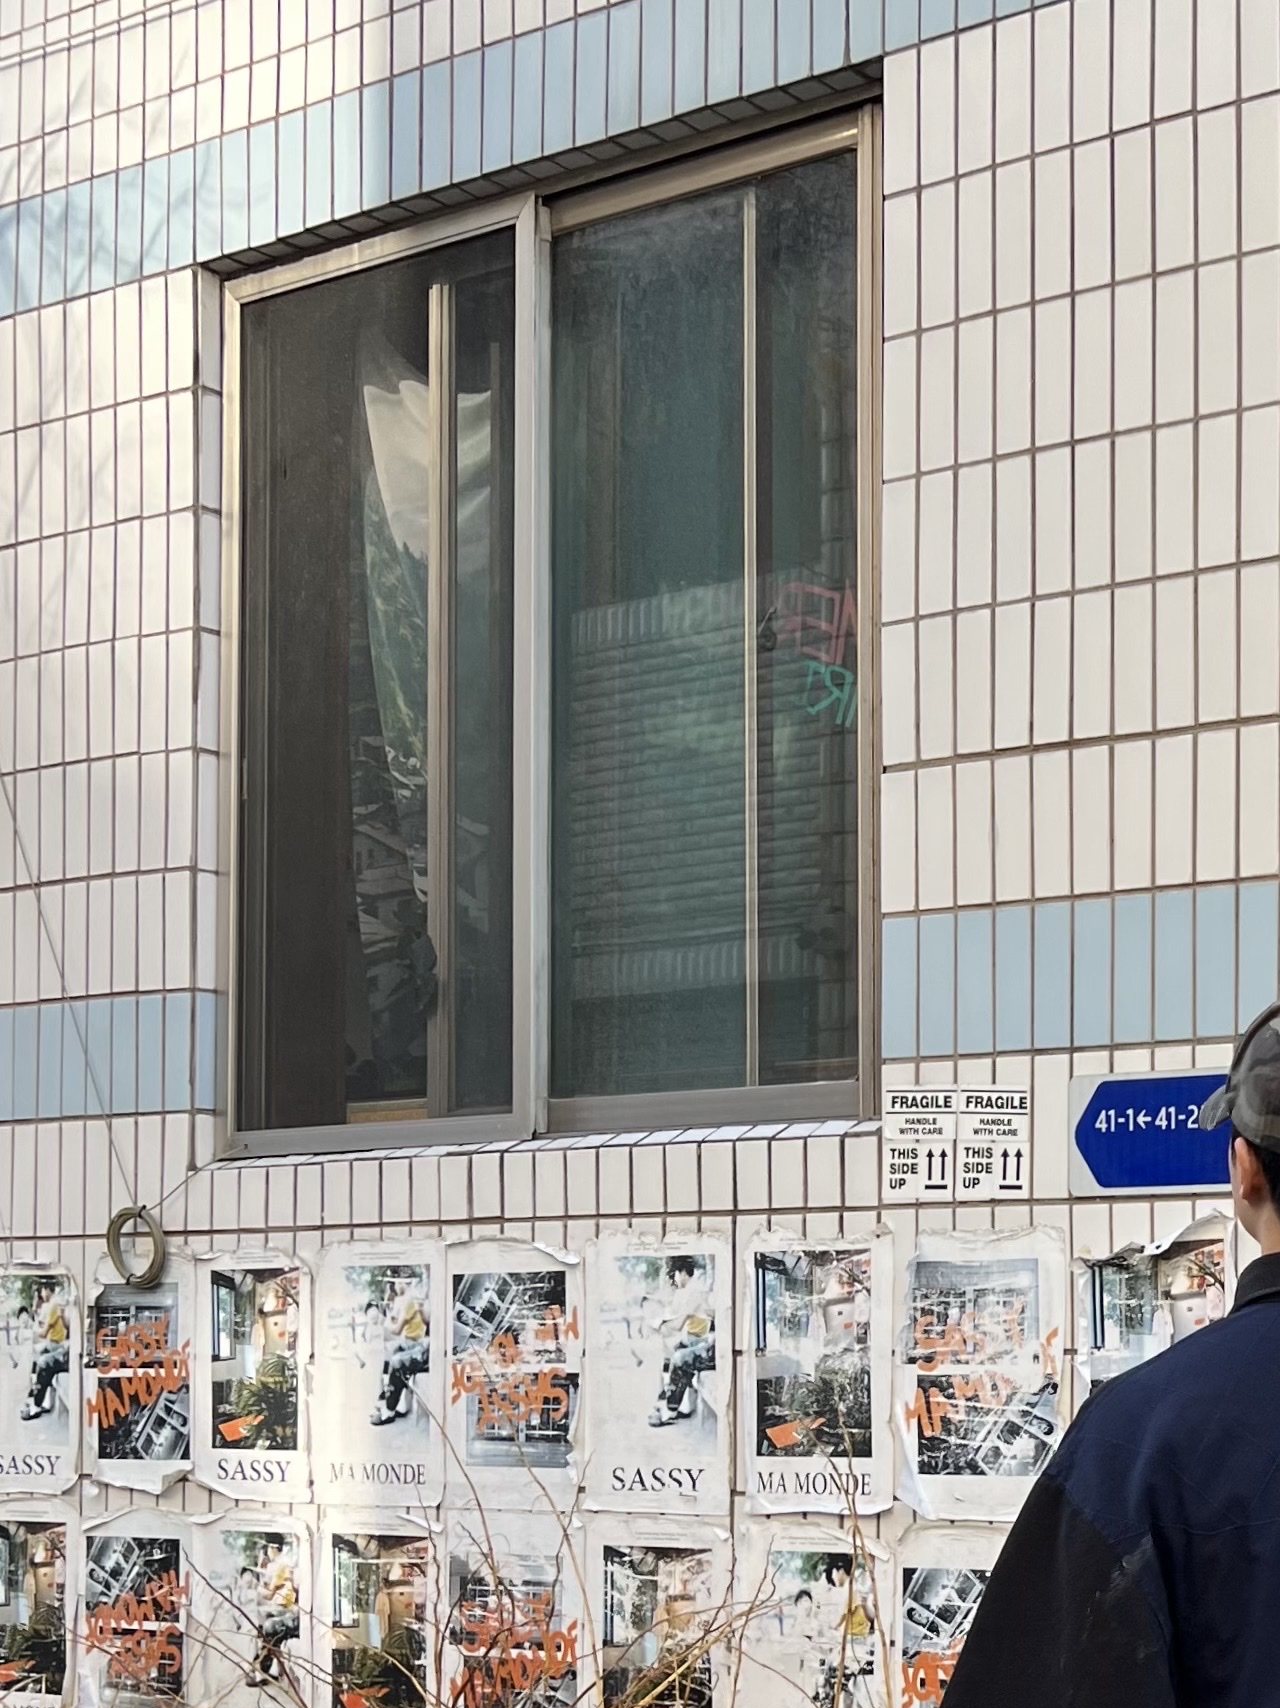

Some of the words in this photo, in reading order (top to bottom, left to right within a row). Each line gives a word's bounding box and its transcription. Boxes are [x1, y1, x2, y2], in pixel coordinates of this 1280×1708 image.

[891, 1095, 952, 1109] FRAGILE
[965, 1096, 1028, 1110] FRAGILE
[904, 1117, 937, 1125] HANDLE
[979, 1118, 1012, 1127] HANDLE
[898, 1127, 919, 1136] WITH
[921, 1127, 943, 1135] CARE
[973, 1128, 994, 1136] WITH
[995, 1128, 1018, 1136] CARE
[890, 1148, 918, 1159] THIS
[964, 1147, 993, 1158] THIS
[889, 1163, 918, 1174] SIDE
[963, 1162, 993, 1174] SIDE
[889, 1178, 906, 1189] UP
[963, 1177, 980, 1189] UP
[216, 1458, 291, 1482] SASSY
[361, 1462, 427, 1486] MONDE
[612, 1466, 705, 1492] SASSY
[757, 1471, 788, 1494] MA
[794, 1472, 872, 1496] MONDE
